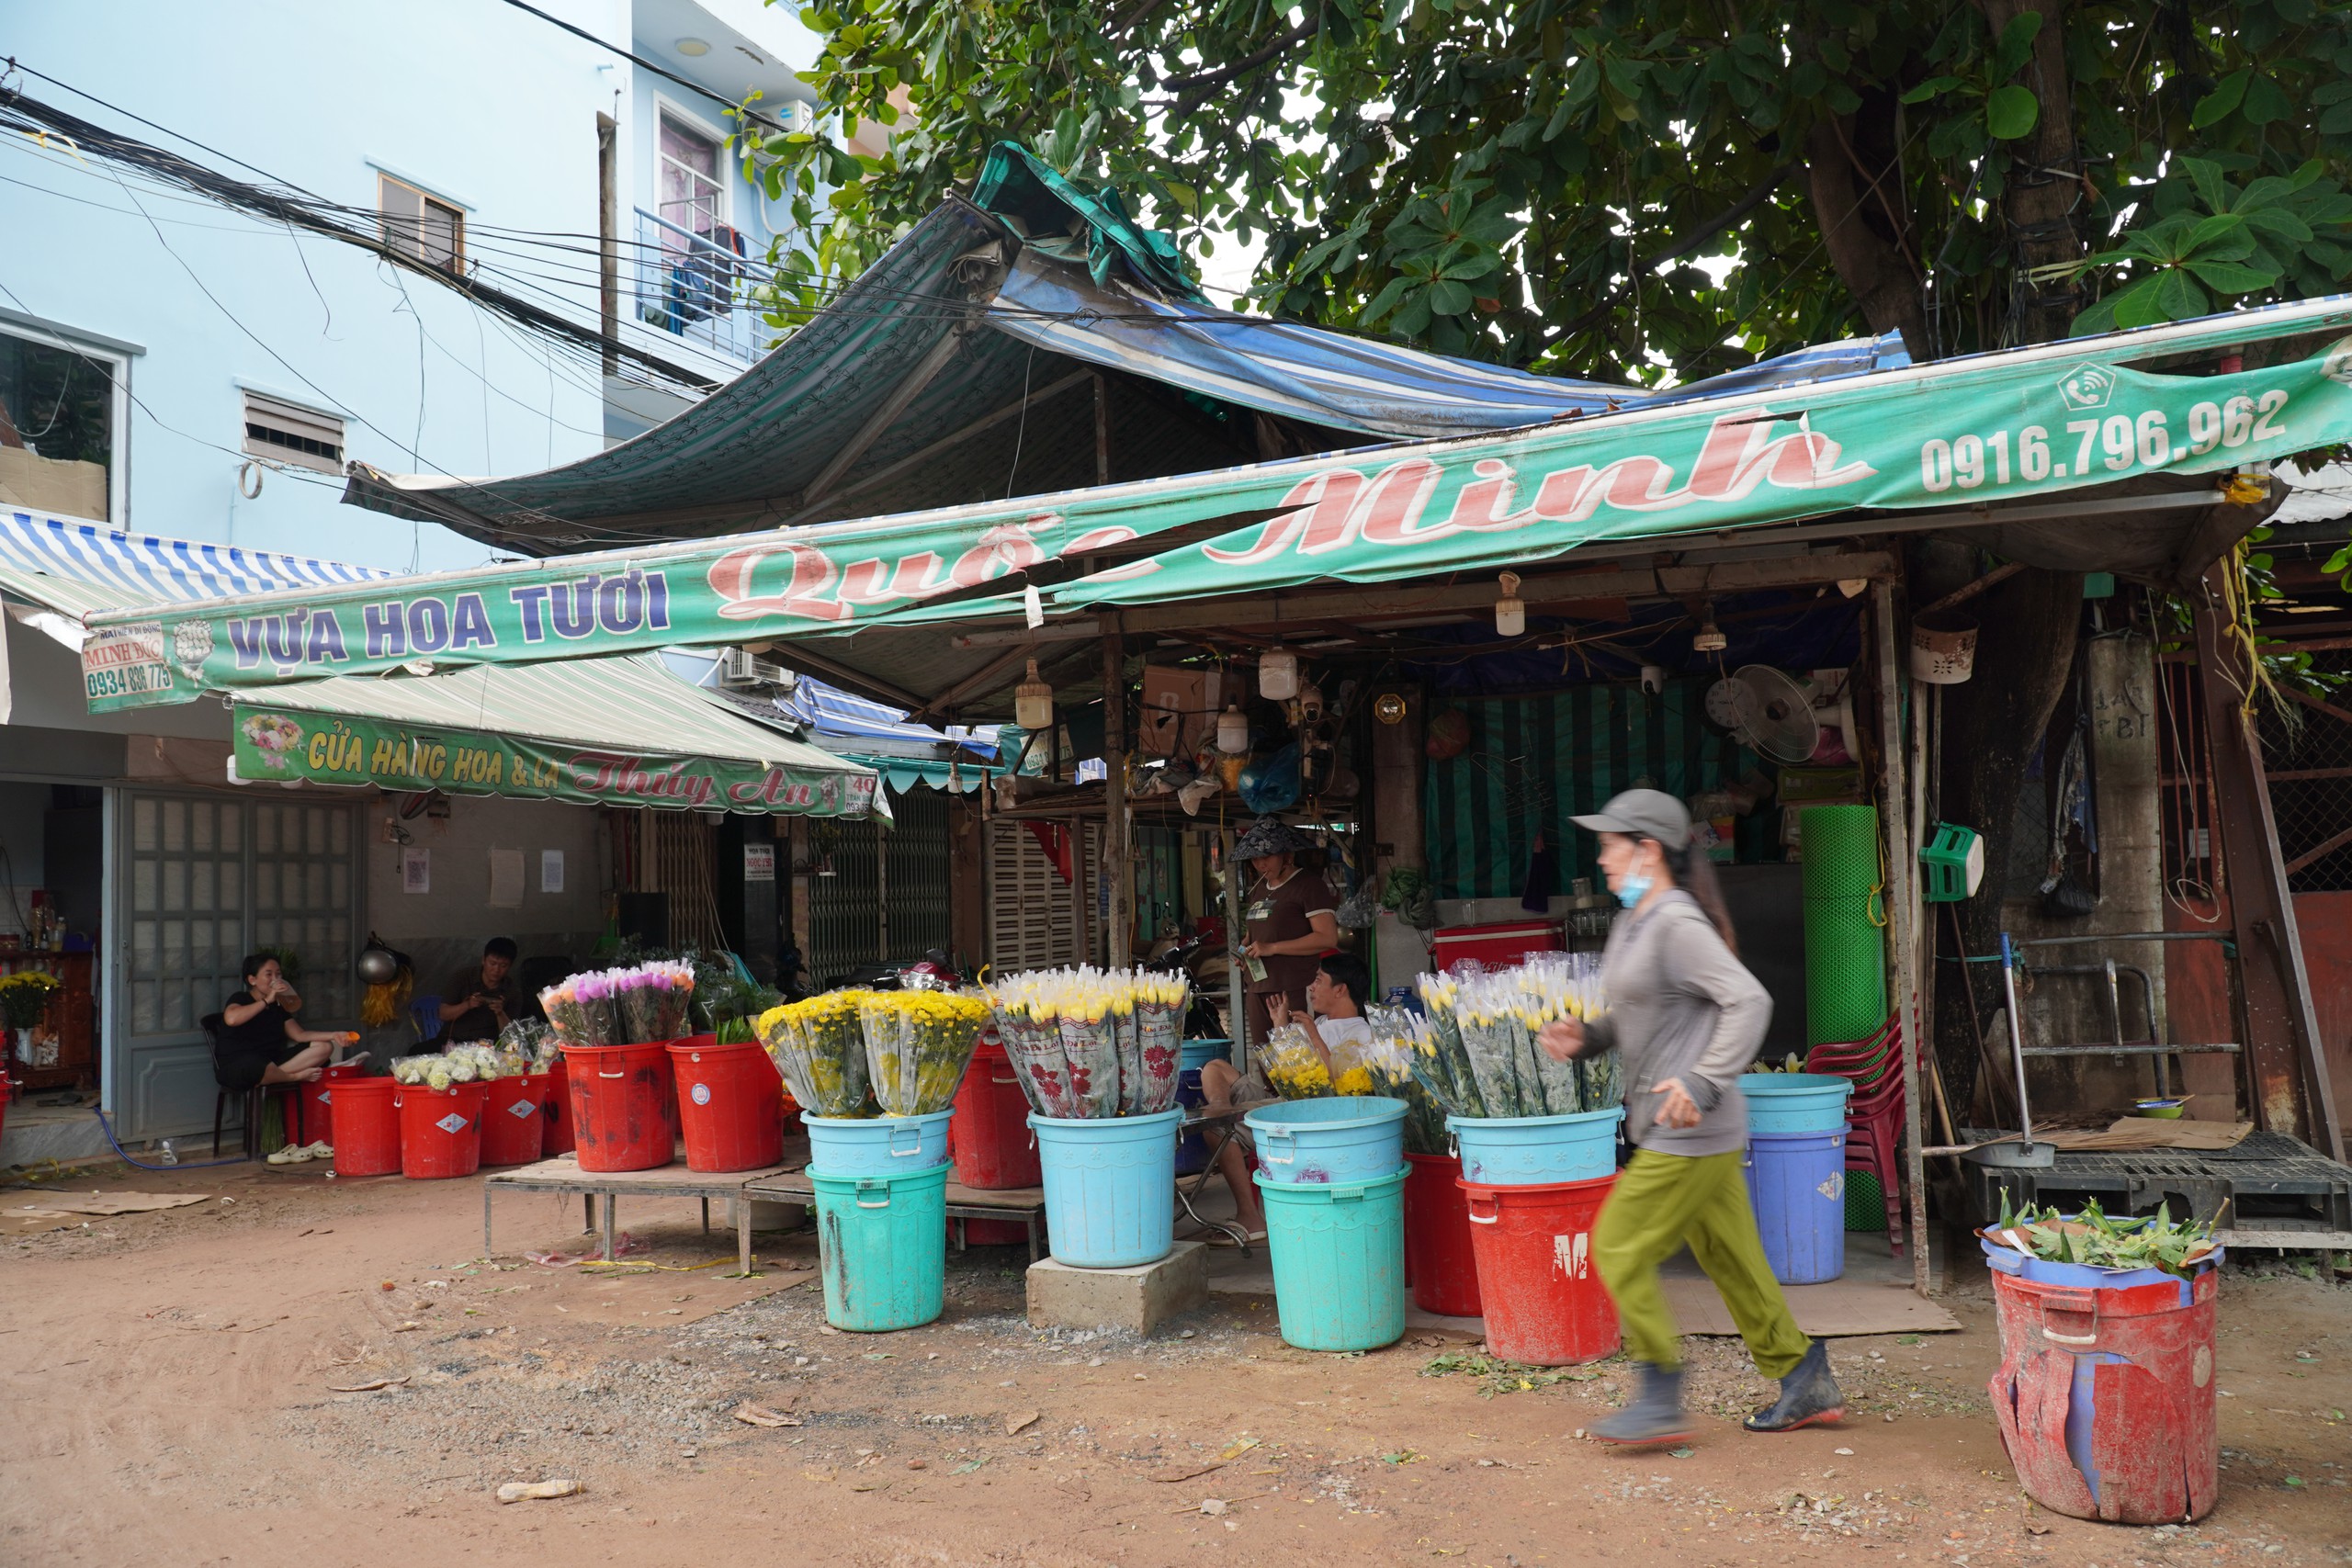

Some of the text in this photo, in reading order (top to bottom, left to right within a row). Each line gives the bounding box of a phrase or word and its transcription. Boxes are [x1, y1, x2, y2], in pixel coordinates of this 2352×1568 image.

[1920, 389, 2290, 493] 0916.796.962
[228, 607, 349, 677] VỰA
[363, 592, 498, 659] HOA
[510, 569, 670, 643] TƯƠI
[1201, 405, 1880, 566] Minh
[84, 641, 132, 669] MINH
[87, 662, 172, 698] 0934 836 775
[308, 719, 815, 811] CỬA HÀNG HOA & LÁ Thúy An
